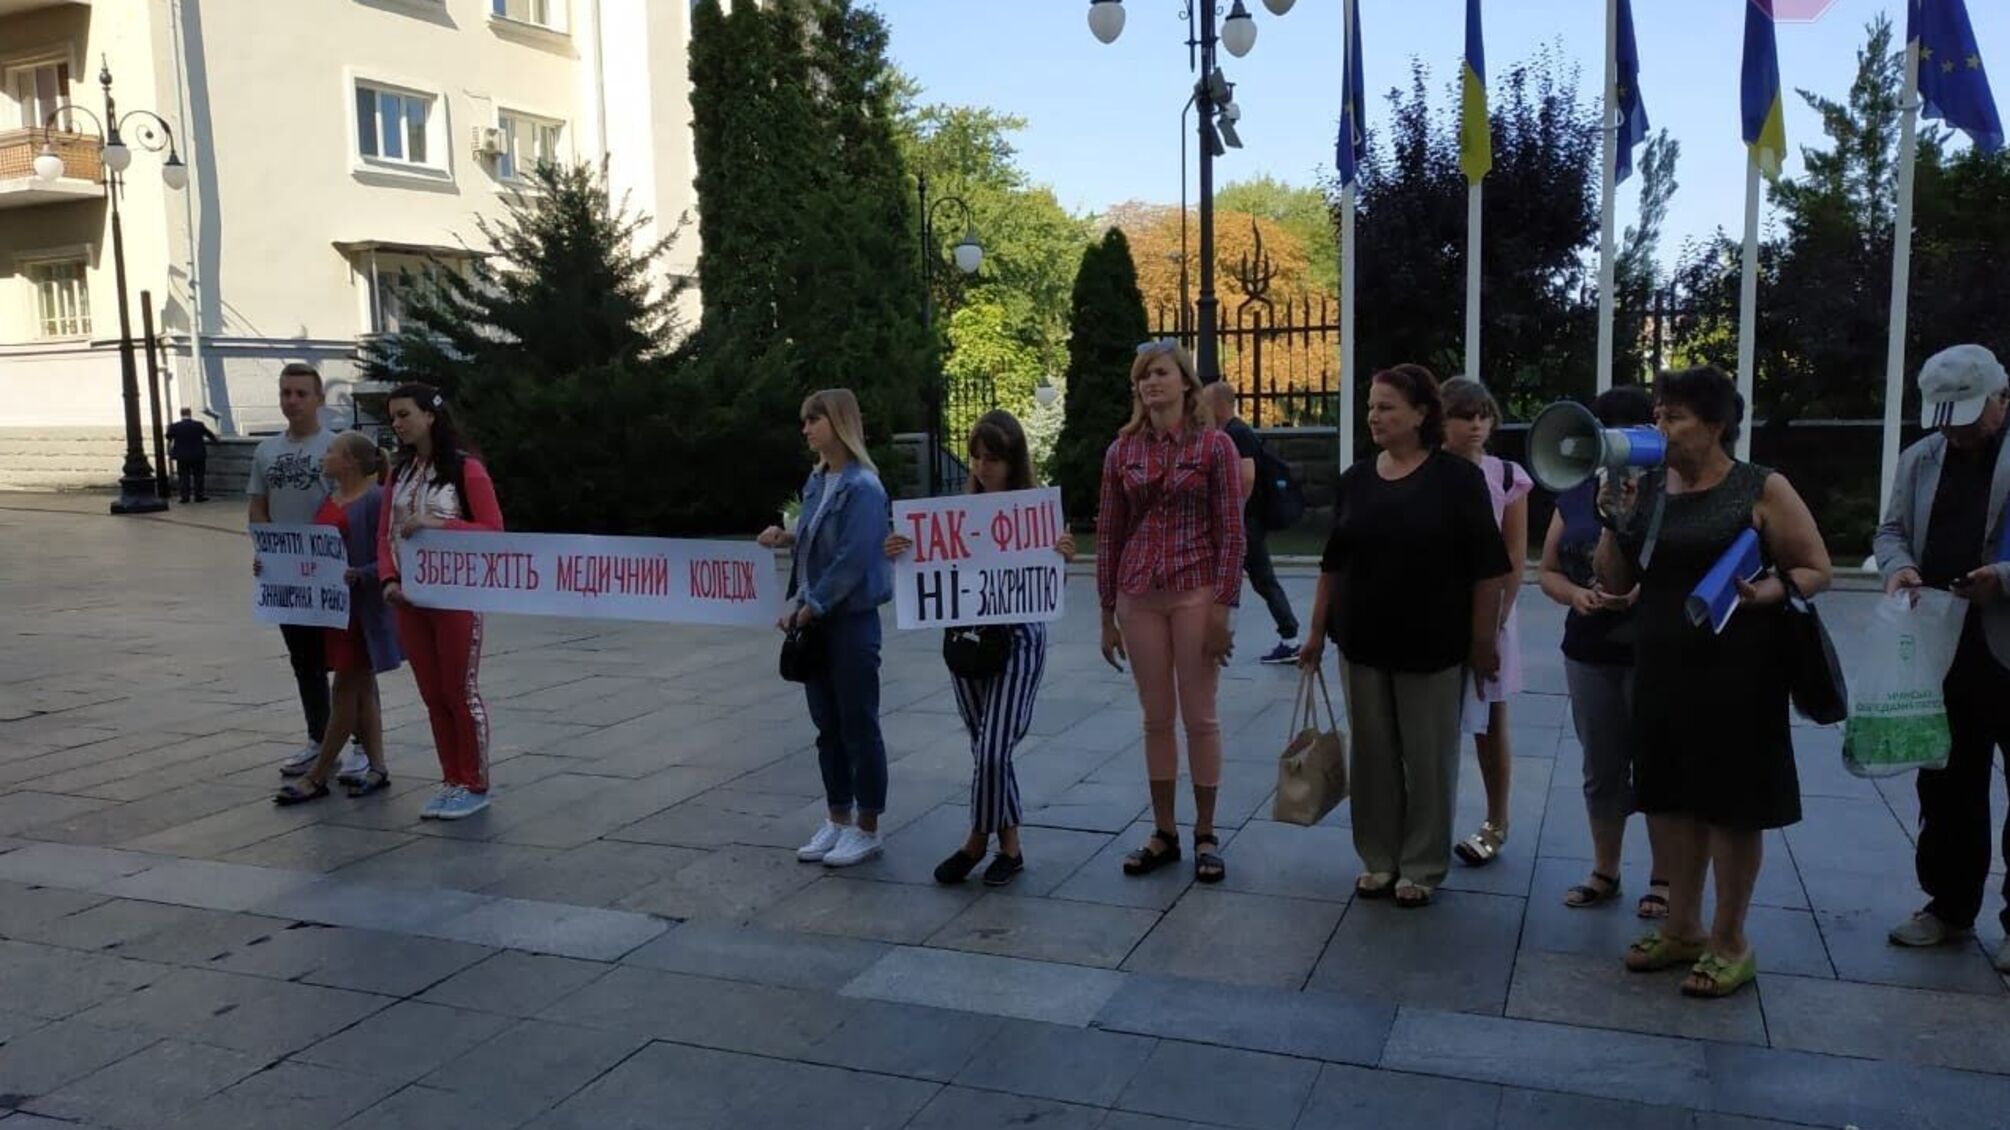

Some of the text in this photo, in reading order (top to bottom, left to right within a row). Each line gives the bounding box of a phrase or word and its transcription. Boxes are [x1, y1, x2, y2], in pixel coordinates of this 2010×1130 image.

[415, 549, 757, 602] ЗБЕРЕЖІТЬ МЕДИЧНИЙ КОЛЕДЖ
[977, 565, 1058, 617] ЗАКРИТТЮ
